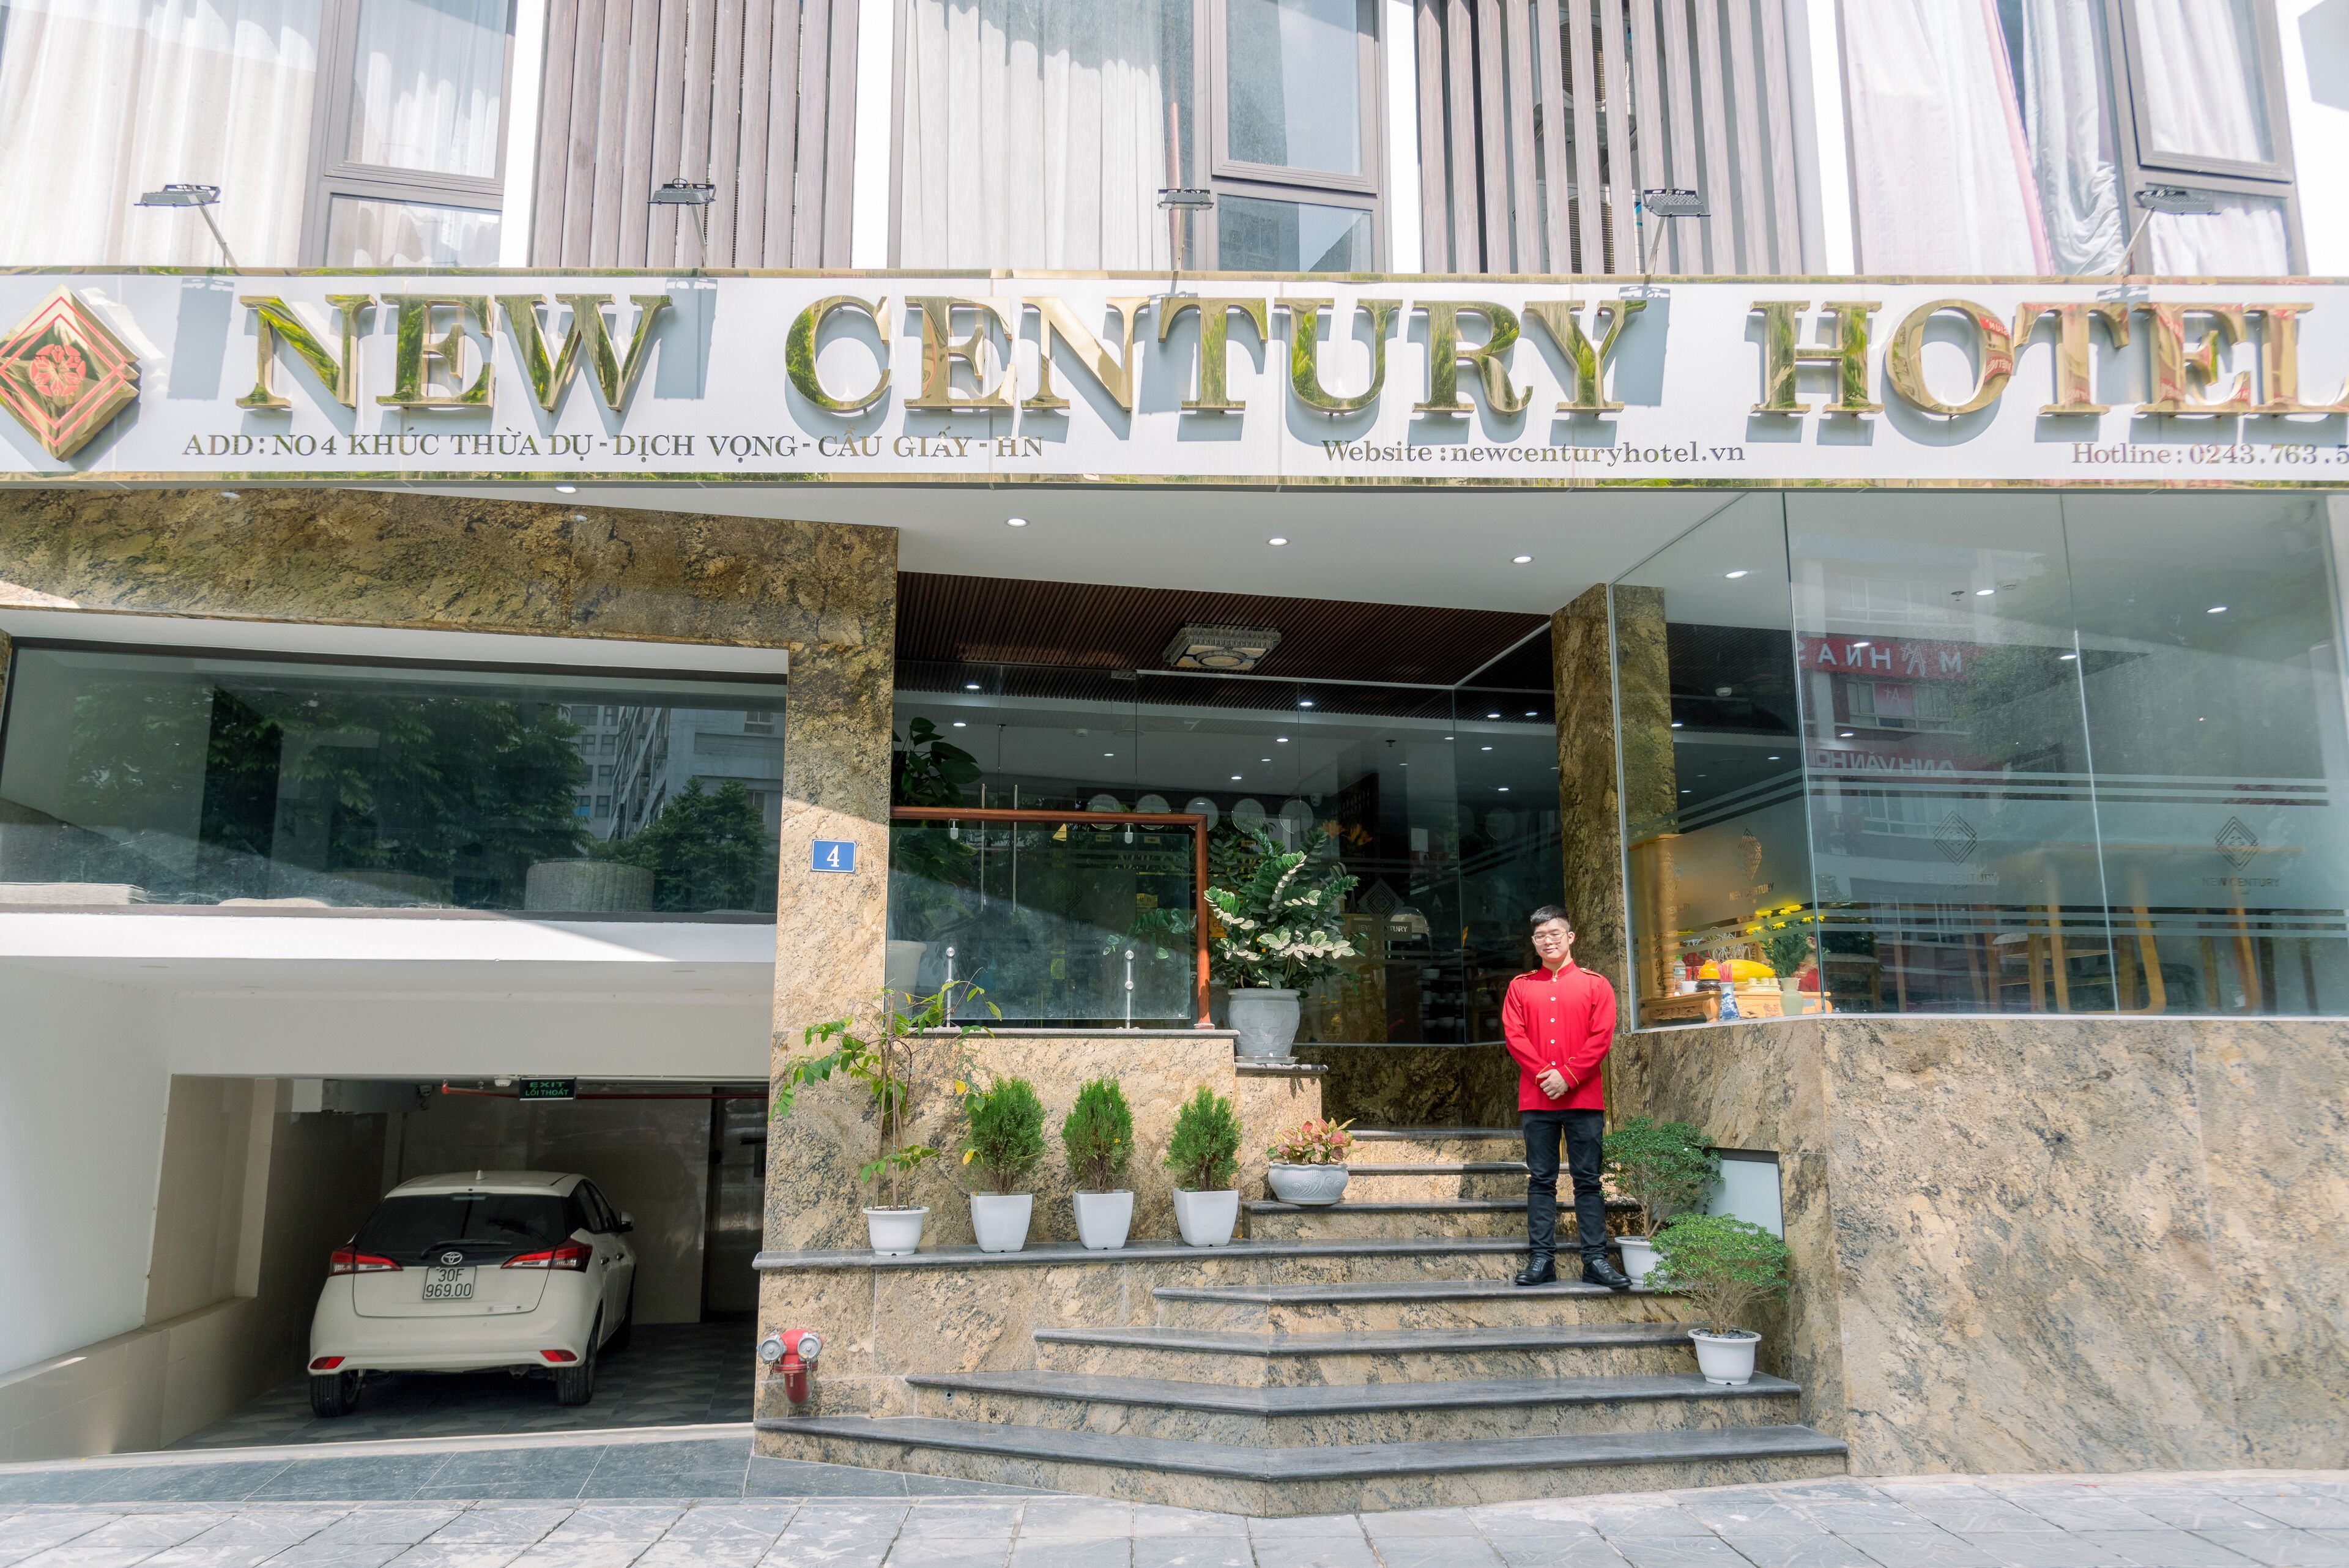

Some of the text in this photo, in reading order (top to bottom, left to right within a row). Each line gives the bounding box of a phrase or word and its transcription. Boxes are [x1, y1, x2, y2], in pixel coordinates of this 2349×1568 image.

[236, 293, 2349, 416] NEW CENTURY HOTEL
[347, 426, 439, 456] KHÚC
[450, 426, 541, 456] THỪA
[893, 425, 973, 458] GIẤY
[996, 436, 1044, 457] HN
[826, 844, 840, 868] 4
[540, 1087, 569, 1096] THOÁT
[438, 1268, 464, 1282] 30F
[425, 1283, 472, 1298] 969.00
